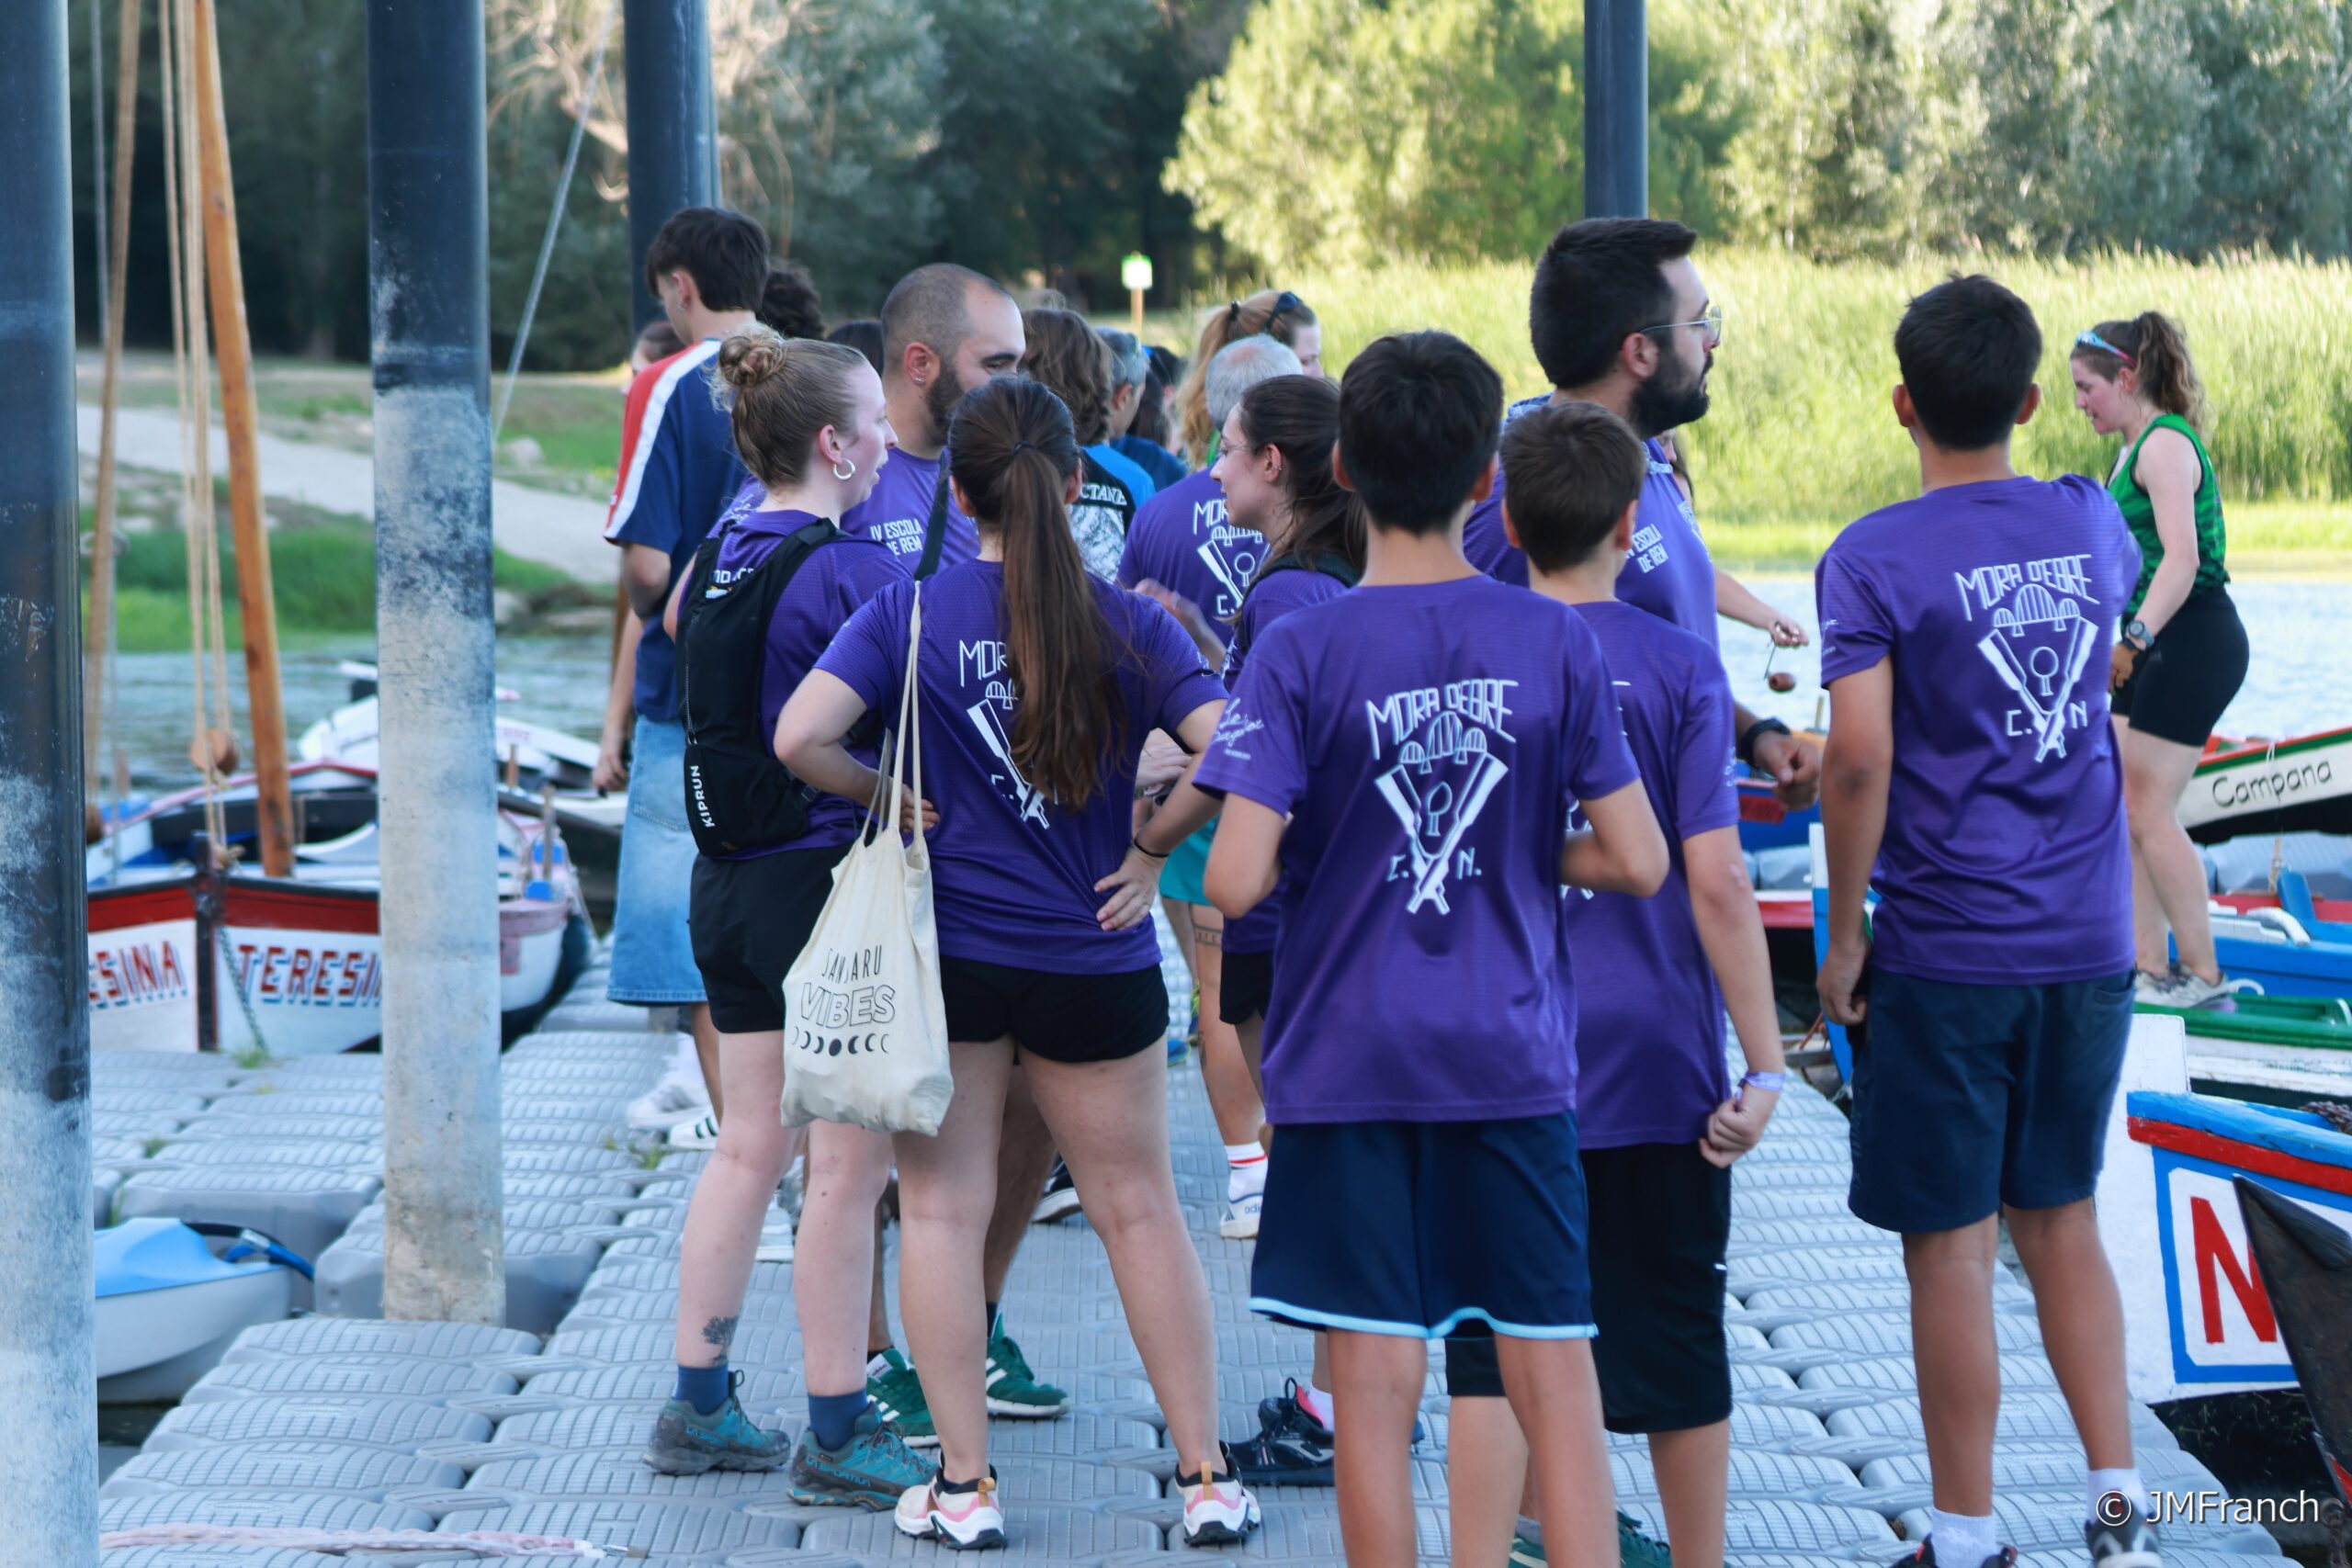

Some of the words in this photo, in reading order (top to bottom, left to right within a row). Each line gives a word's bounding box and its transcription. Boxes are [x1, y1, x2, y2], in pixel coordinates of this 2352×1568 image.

[884, 518, 923, 539] ESCOLA
[1953, 563, 2023, 622] MORA
[959, 638, 1009, 688] MOR
[1365, 684, 1441, 761] MORA
[689, 765, 716, 828] KIPRUN
[2212, 760, 2333, 808] Campana
[238, 943, 382, 1008] TERESI
[801, 982, 896, 1029] VIBES
